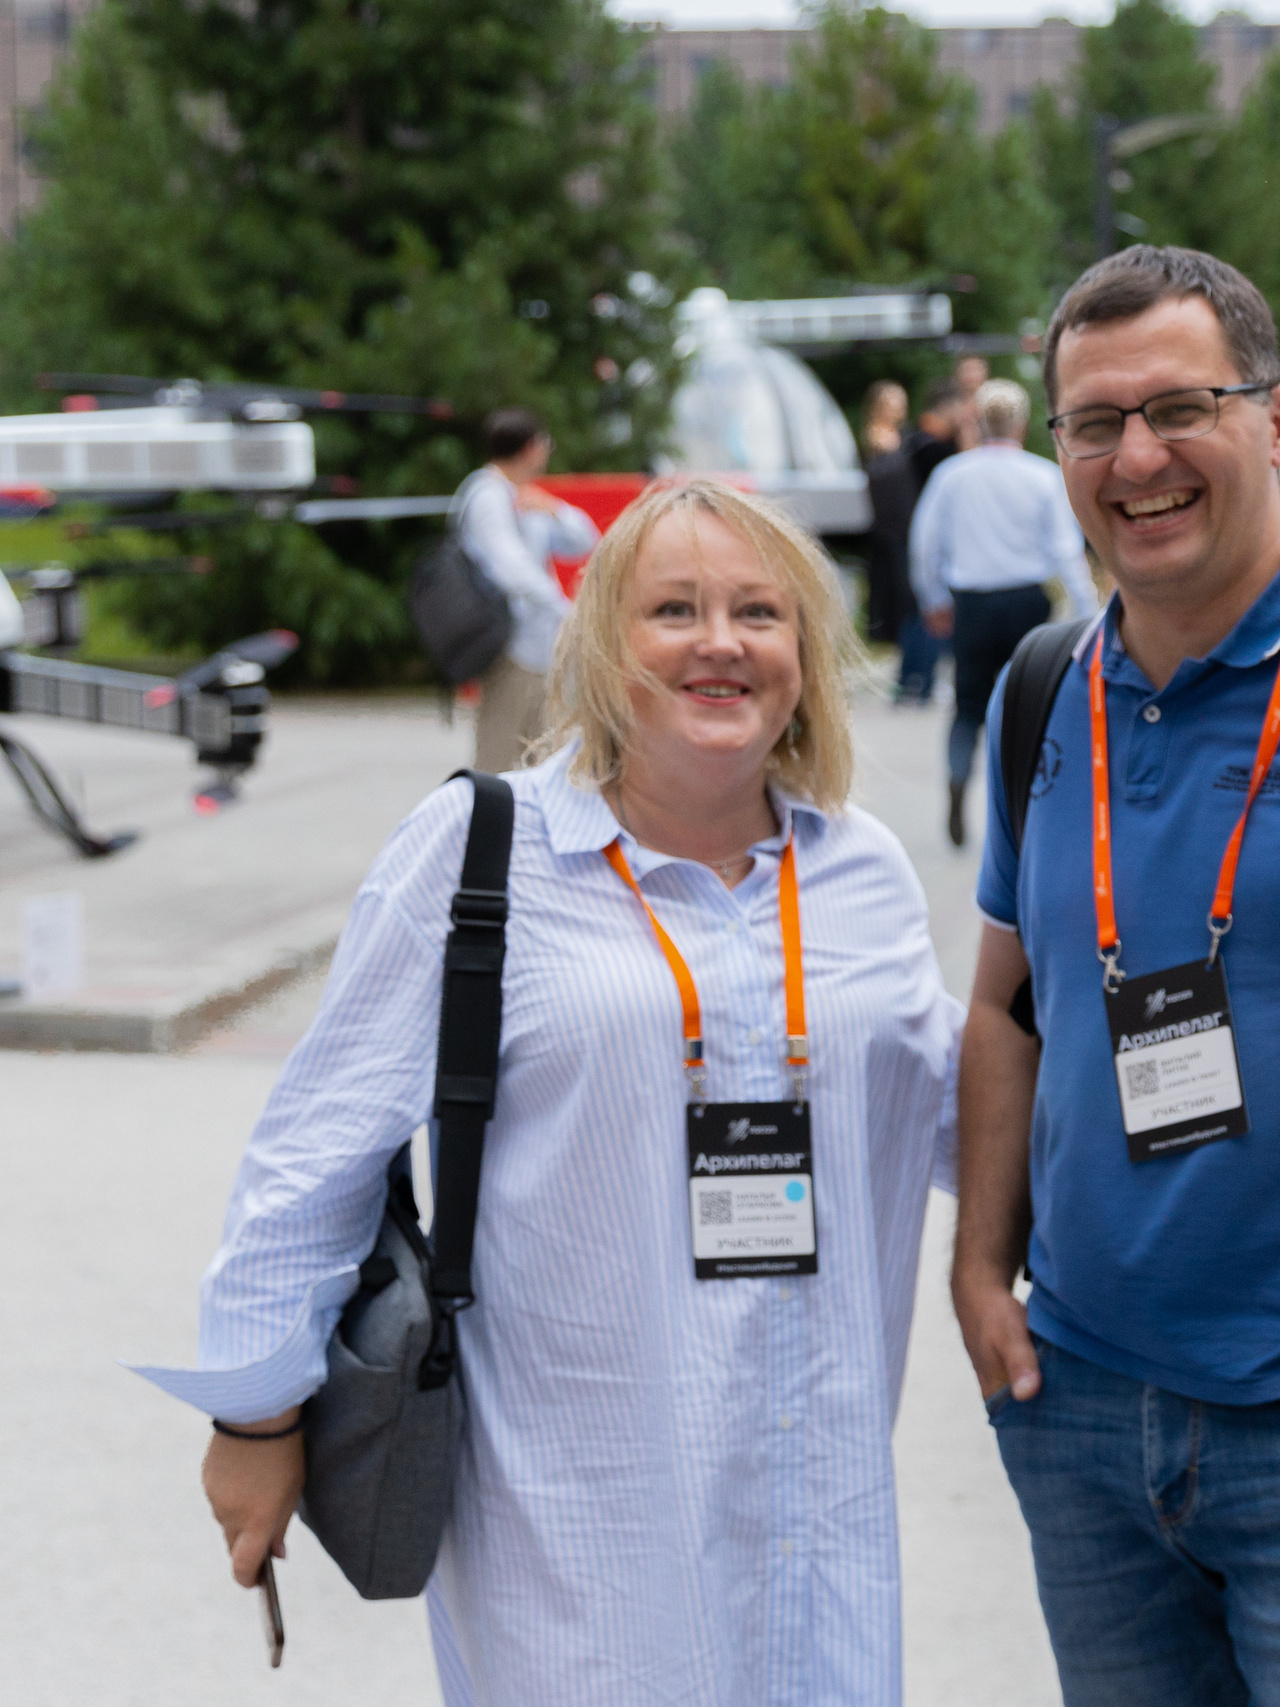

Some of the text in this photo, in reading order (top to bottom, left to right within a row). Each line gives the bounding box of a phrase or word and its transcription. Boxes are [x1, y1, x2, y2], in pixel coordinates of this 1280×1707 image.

[1118, 1011, 1223, 1052] Архипелаг
[1150, 1096, 1217, 1120] УЧАСТНИК
[694, 1152, 805, 1175] Архипелаг
[716, 1237, 794, 1250] УЧАСТНИК
